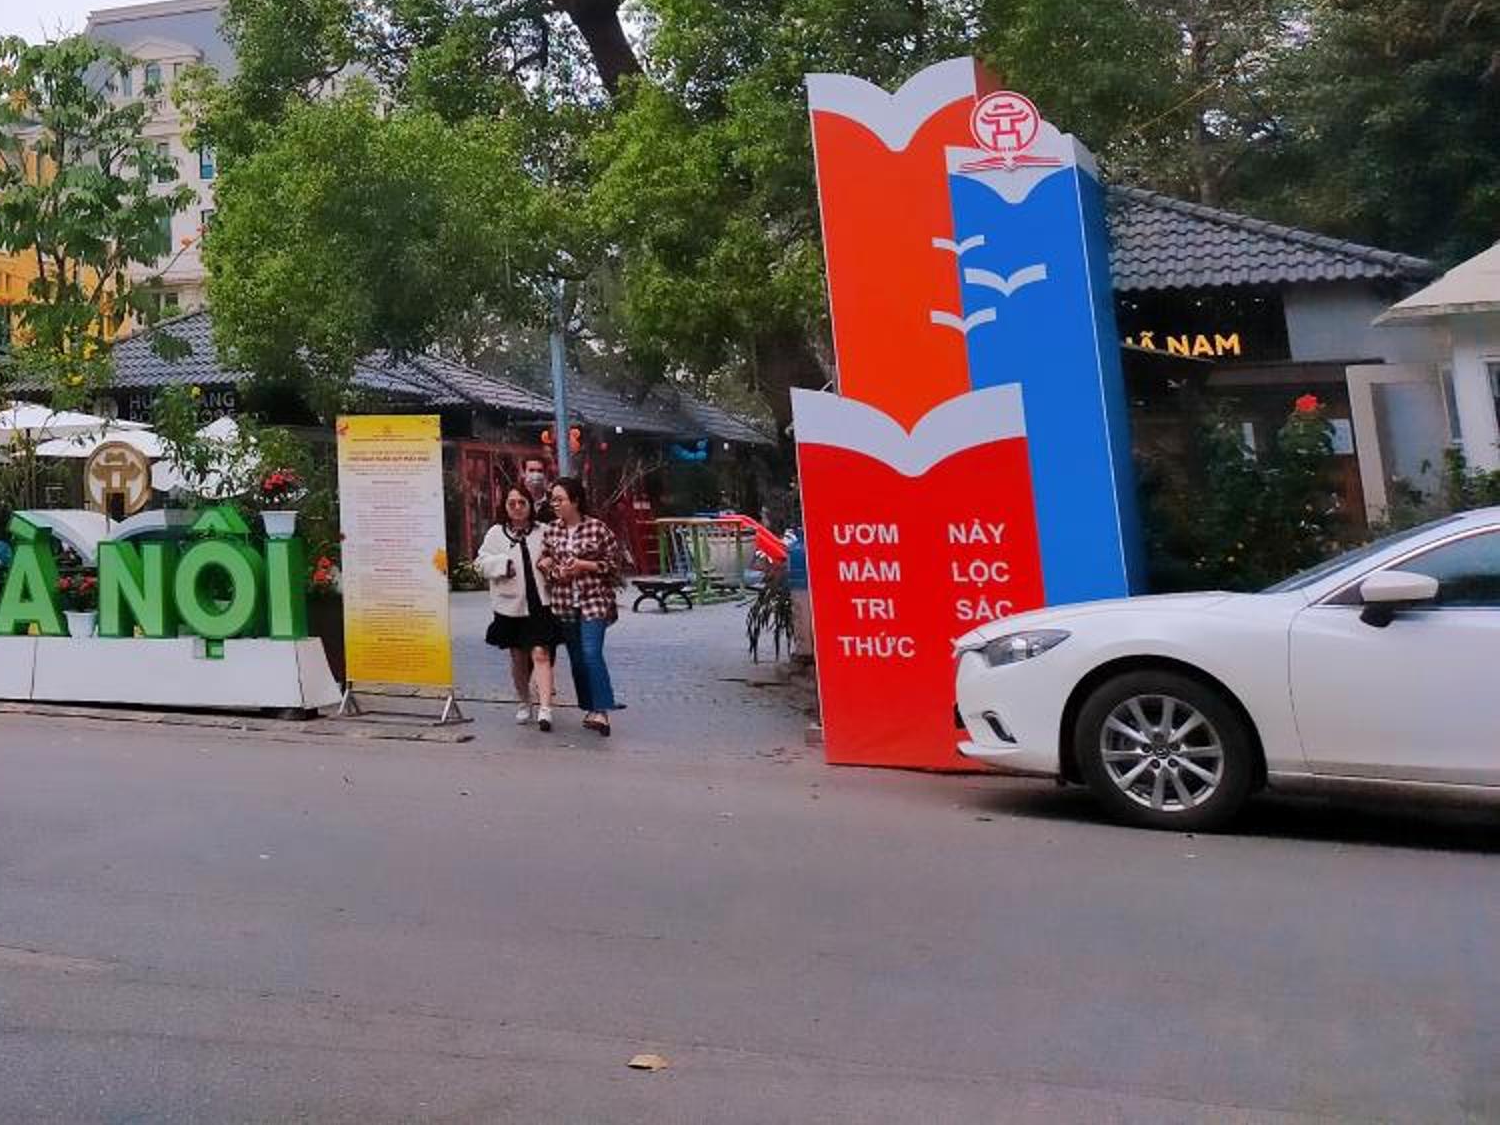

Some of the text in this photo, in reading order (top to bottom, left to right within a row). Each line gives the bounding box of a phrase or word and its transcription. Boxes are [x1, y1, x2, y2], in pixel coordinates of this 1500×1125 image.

[1166, 333, 1241, 356] NAM
[98, 507, 308, 660] NỘI
[851, 598, 895, 620] TRI
[837, 631, 916, 658] THỨC
